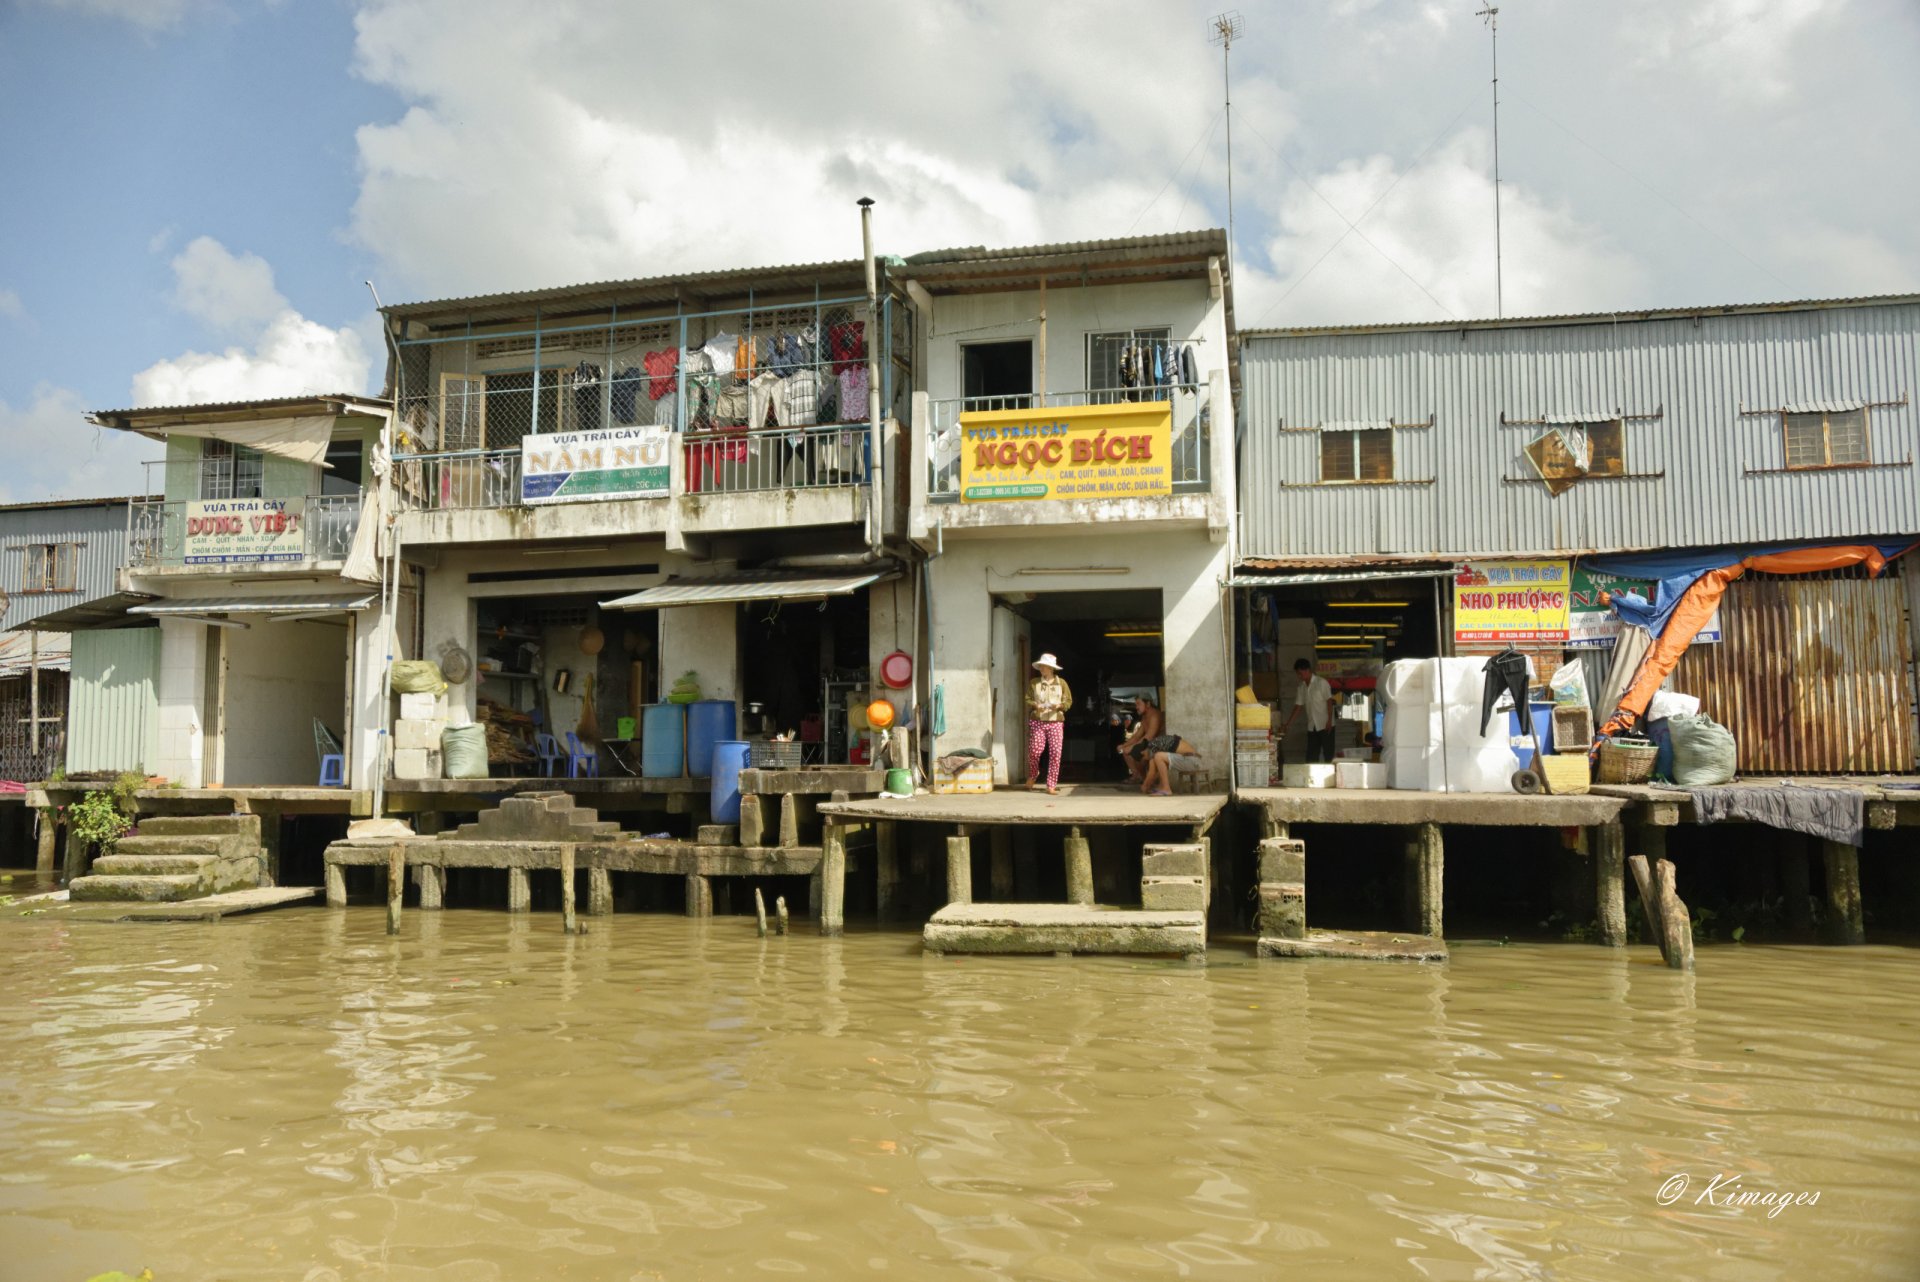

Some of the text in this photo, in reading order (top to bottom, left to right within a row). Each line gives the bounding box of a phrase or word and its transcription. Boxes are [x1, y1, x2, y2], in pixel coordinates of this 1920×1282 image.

[553, 430, 640, 445] VỰA TRÁI CÂY
[968, 421, 1069, 442] VỰA TRÁI CÂY
[976, 428, 1152, 471] NGỌC BÍCH
[1140, 466, 1164, 476] CHANH
[203, 499, 286, 514] VỰA TRÁI CÂY
[1487, 566, 1511, 584] VỰA
[1541, 564, 1564, 581] CÂY
[1459, 588, 1564, 613] NHO PHƯỢNG
